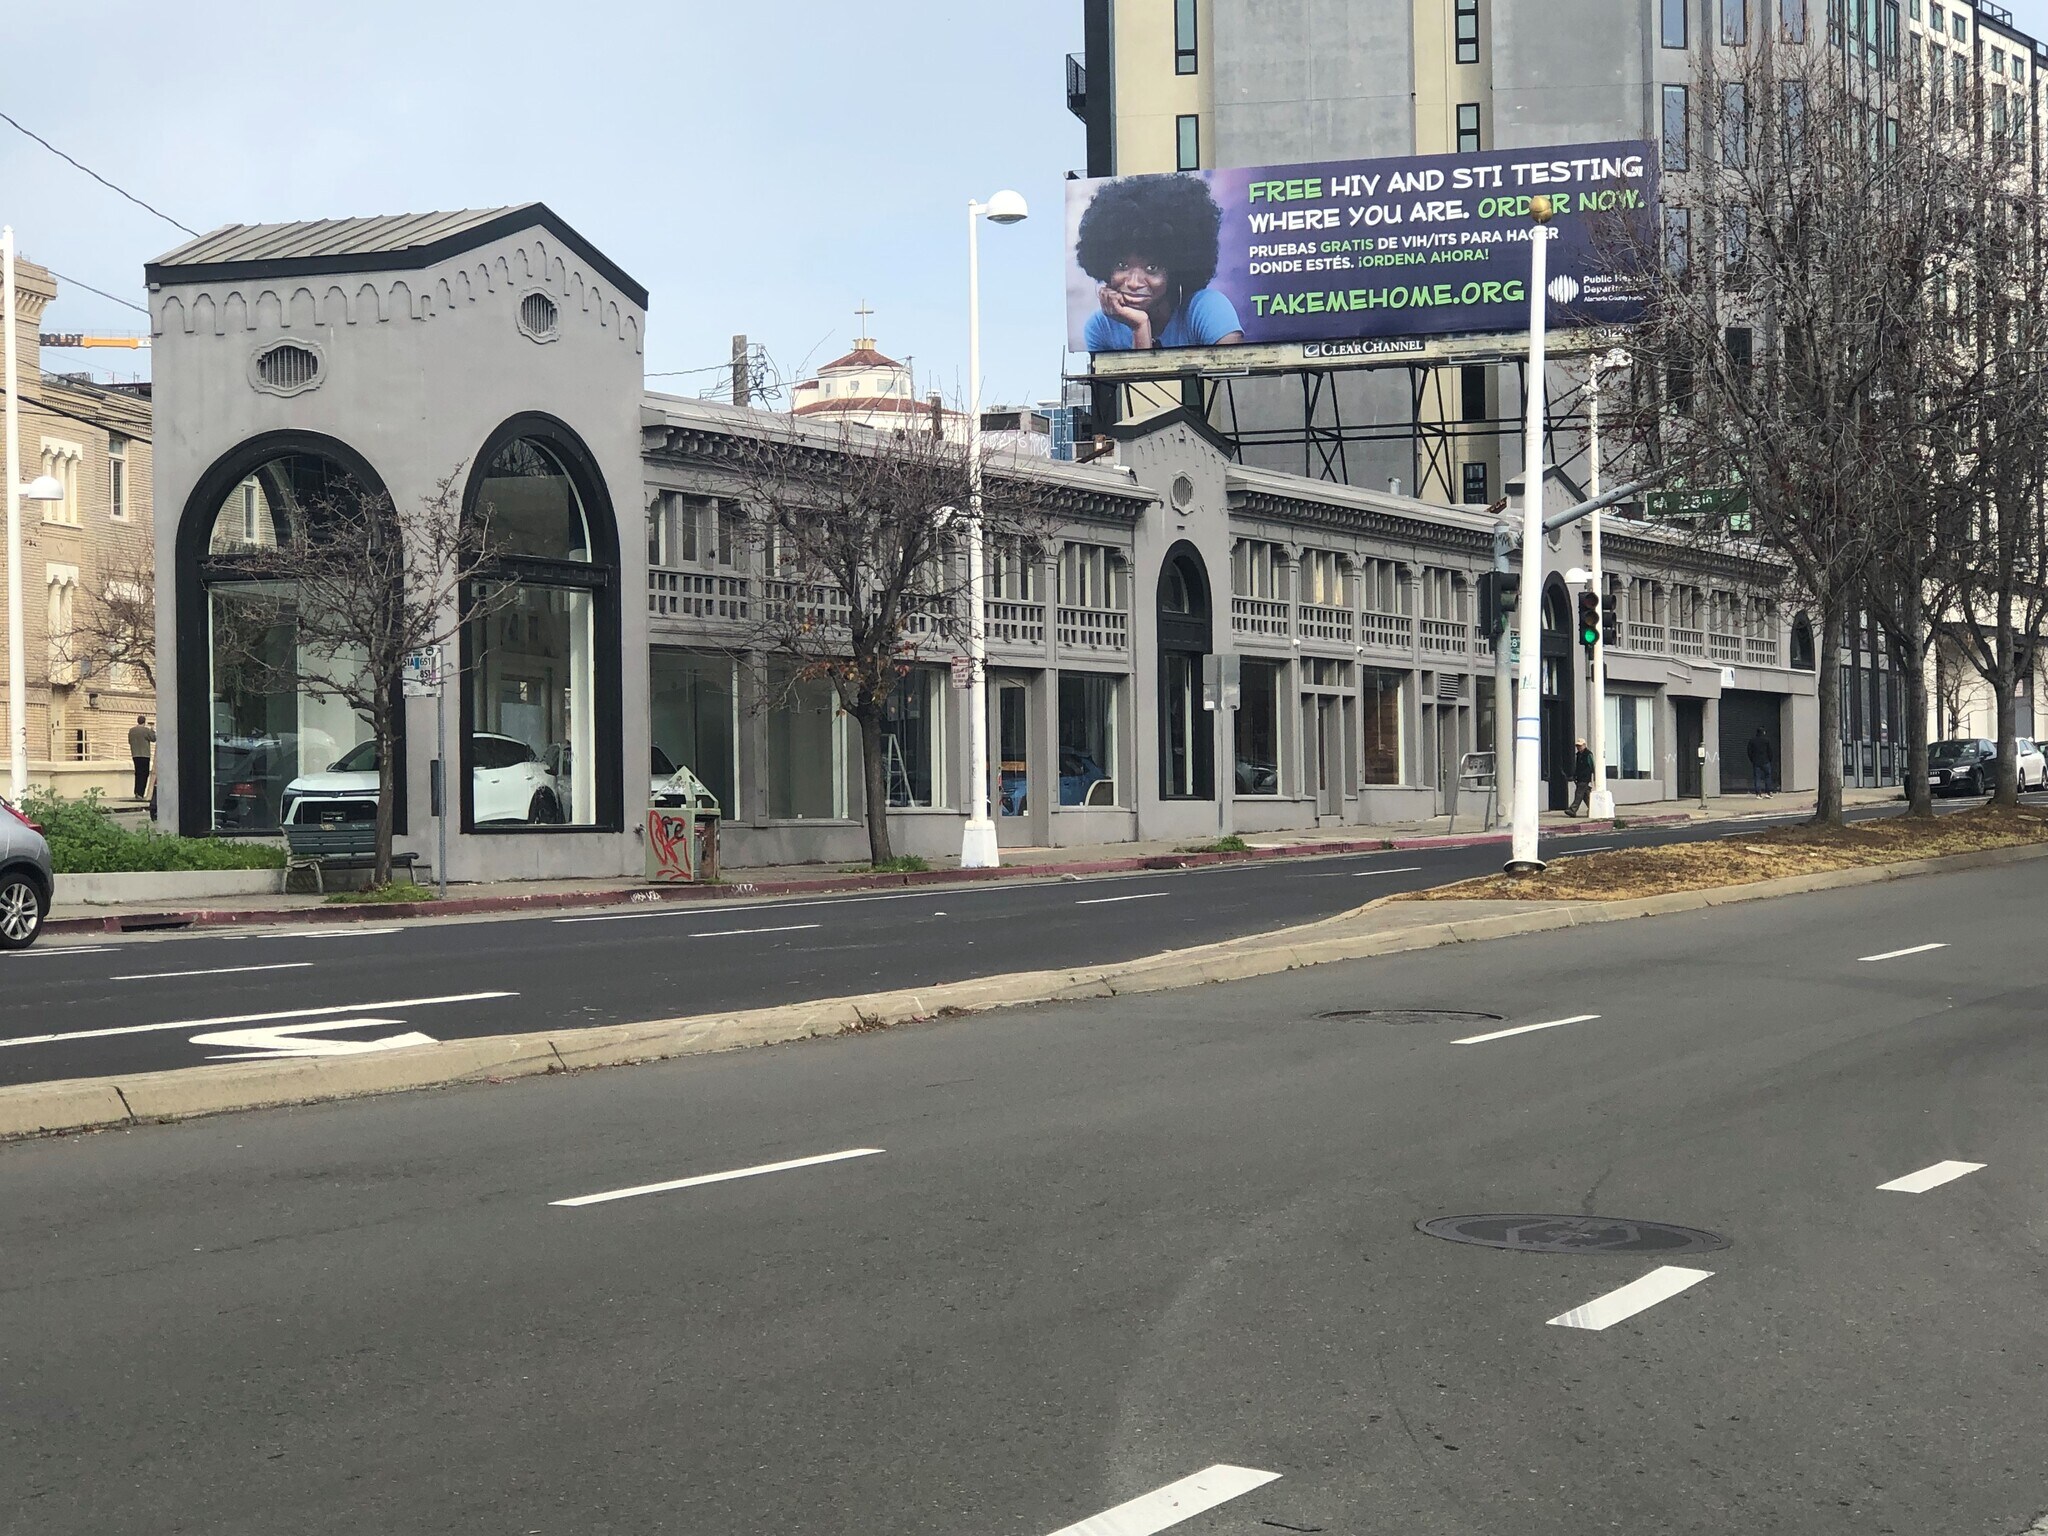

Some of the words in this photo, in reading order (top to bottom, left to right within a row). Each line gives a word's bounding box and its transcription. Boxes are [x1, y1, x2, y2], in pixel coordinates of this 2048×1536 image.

[1249, 177, 1323, 203] FREE
[1330, 173, 1381, 198] HIV
[1387, 169, 1444, 193] AND
[1452, 164, 1502, 190] STI
[1511, 155, 1644, 186] TESTING
[1249, 207, 1340, 234] WHERE
[1348, 205, 1402, 227] YOU
[1409, 199, 1470, 223] ARE.
[1478, 193, 1570, 219] ORDR
[1579, 189, 1645, 212] NOW.
[1249, 242, 1317, 257] PRUEBAS
[1320, 238, 1374, 253] GRATIS
[1377, 237, 1399, 250] DE
[1401, 232, 1457, 249] VIH/ITS
[1461, 230, 1502, 244] PARA
[1249, 259, 1302, 274] DONDE
[1306, 254, 1354, 271] ESTÉS.
[1358, 252, 1426, 268] ¡ORDENA
[1429, 249, 1489, 265] AHORA!
[1584, 275, 1612, 283] Public
[1251, 280, 1524, 316] TAKEMEHOME.ORG
[1320, 343, 1362, 355] CLEAR
[1362, 341, 1423, 353] CHANNEL
